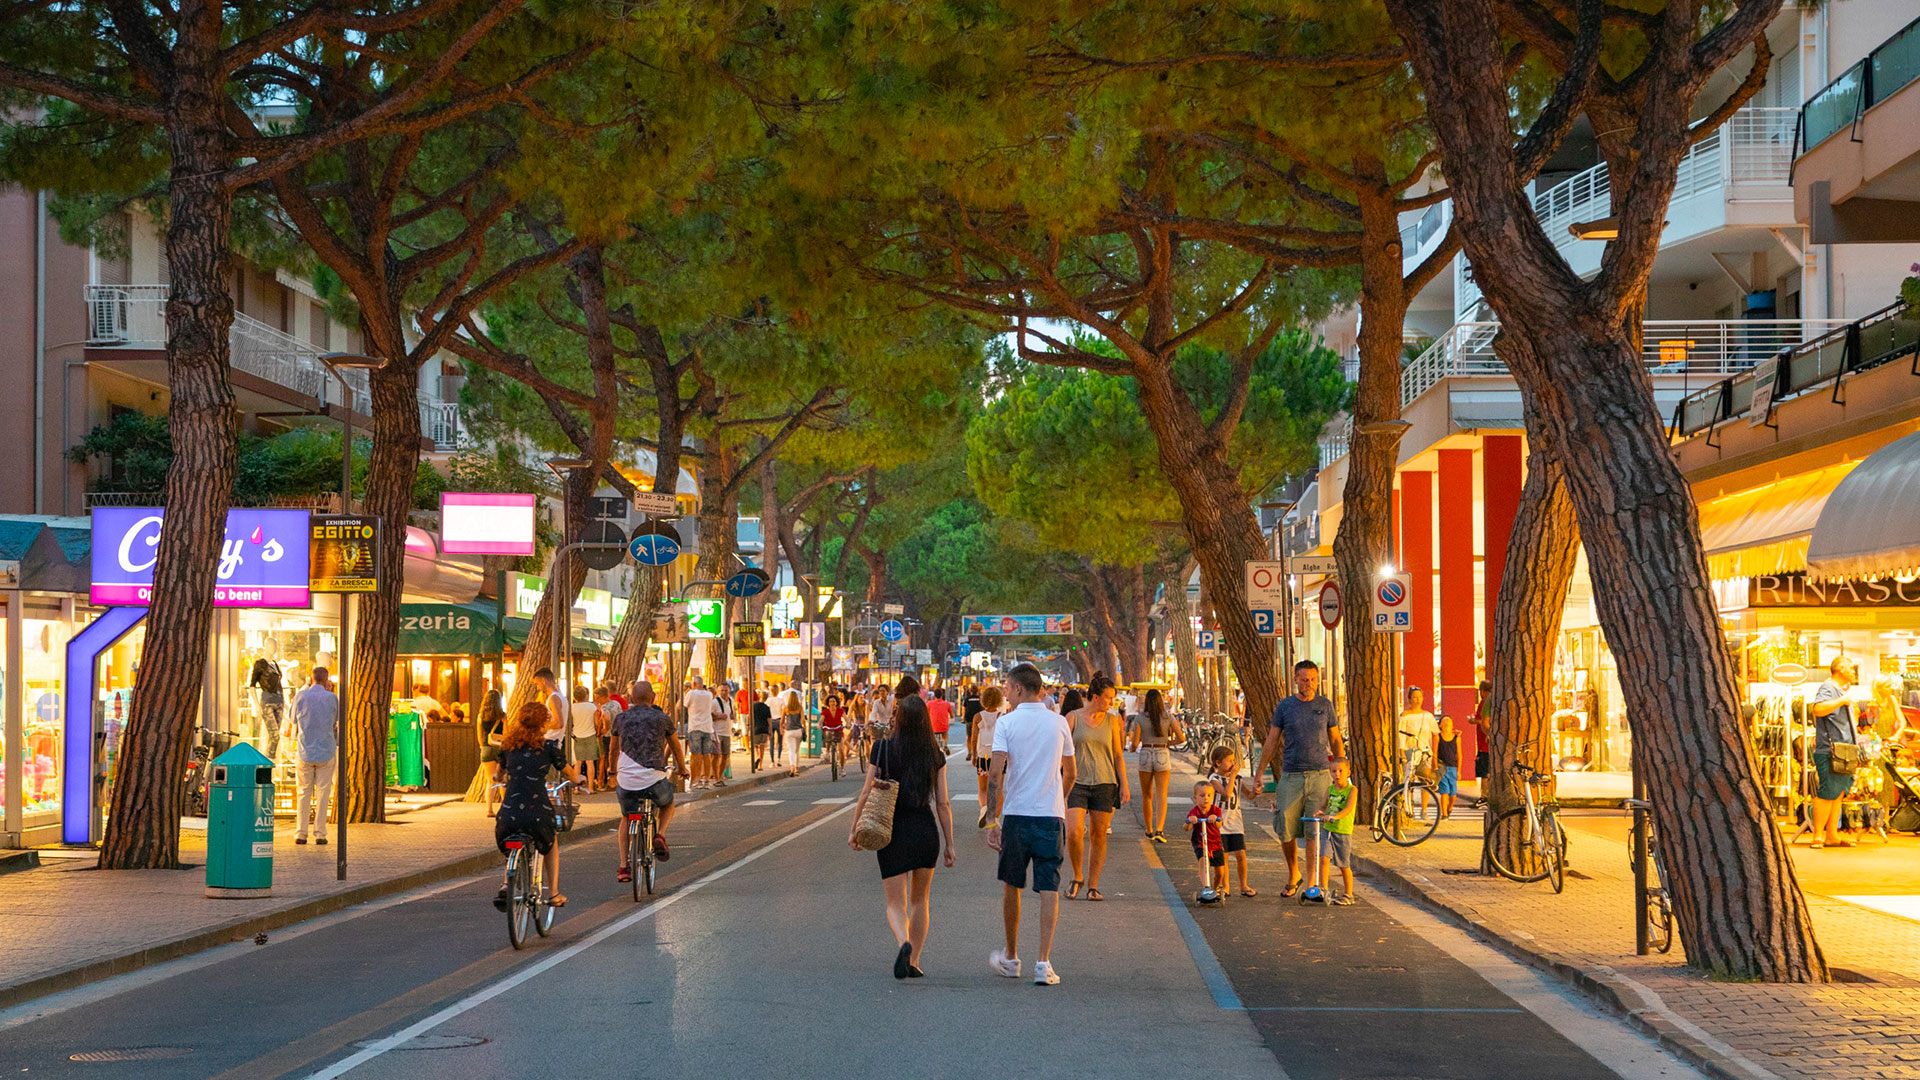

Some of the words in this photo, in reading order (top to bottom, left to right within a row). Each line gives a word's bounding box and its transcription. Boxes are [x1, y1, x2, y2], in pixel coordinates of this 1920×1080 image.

[313, 525, 373, 539] EGITTO
[229, 589, 262, 601] bene!
[399, 611, 471, 630] zeria
[1255, 613, 1268, 631] P
[1378, 615, 1386, 625] P
[1202, 632, 1214, 648] P
